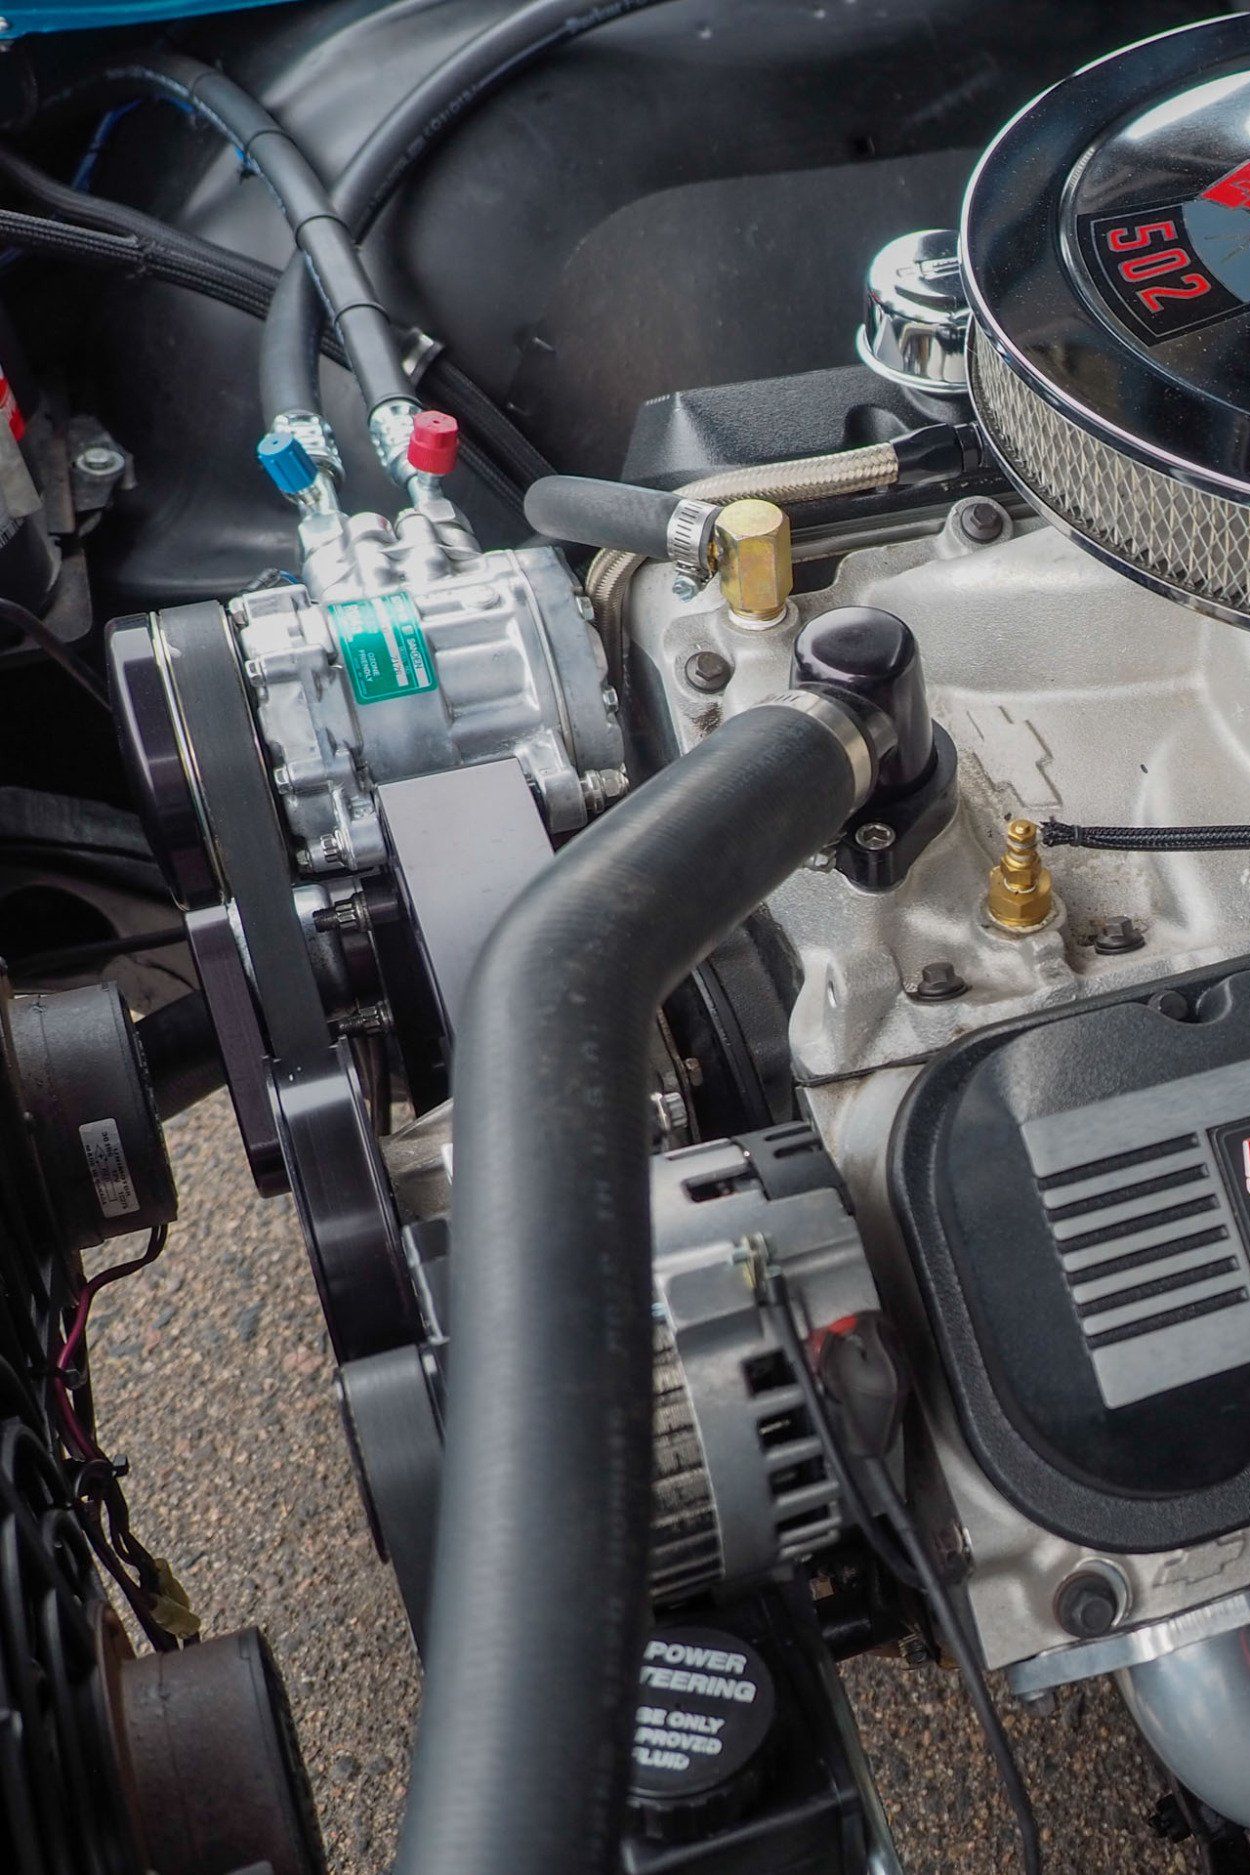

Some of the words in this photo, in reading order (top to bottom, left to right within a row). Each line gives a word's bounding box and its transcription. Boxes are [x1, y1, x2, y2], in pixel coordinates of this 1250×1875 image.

[1107, 220, 1212, 313] 502
[358, 649, 373, 681] FRIENDLY
[367, 652, 380, 677] OZONE
[643, 1640, 747, 1675] POWER
[639, 1665, 757, 1703] TEERING
[635, 1706, 667, 1726] SE
[666, 1710, 726, 1734] ONLY
[633, 1726, 723, 1755] PROVED
